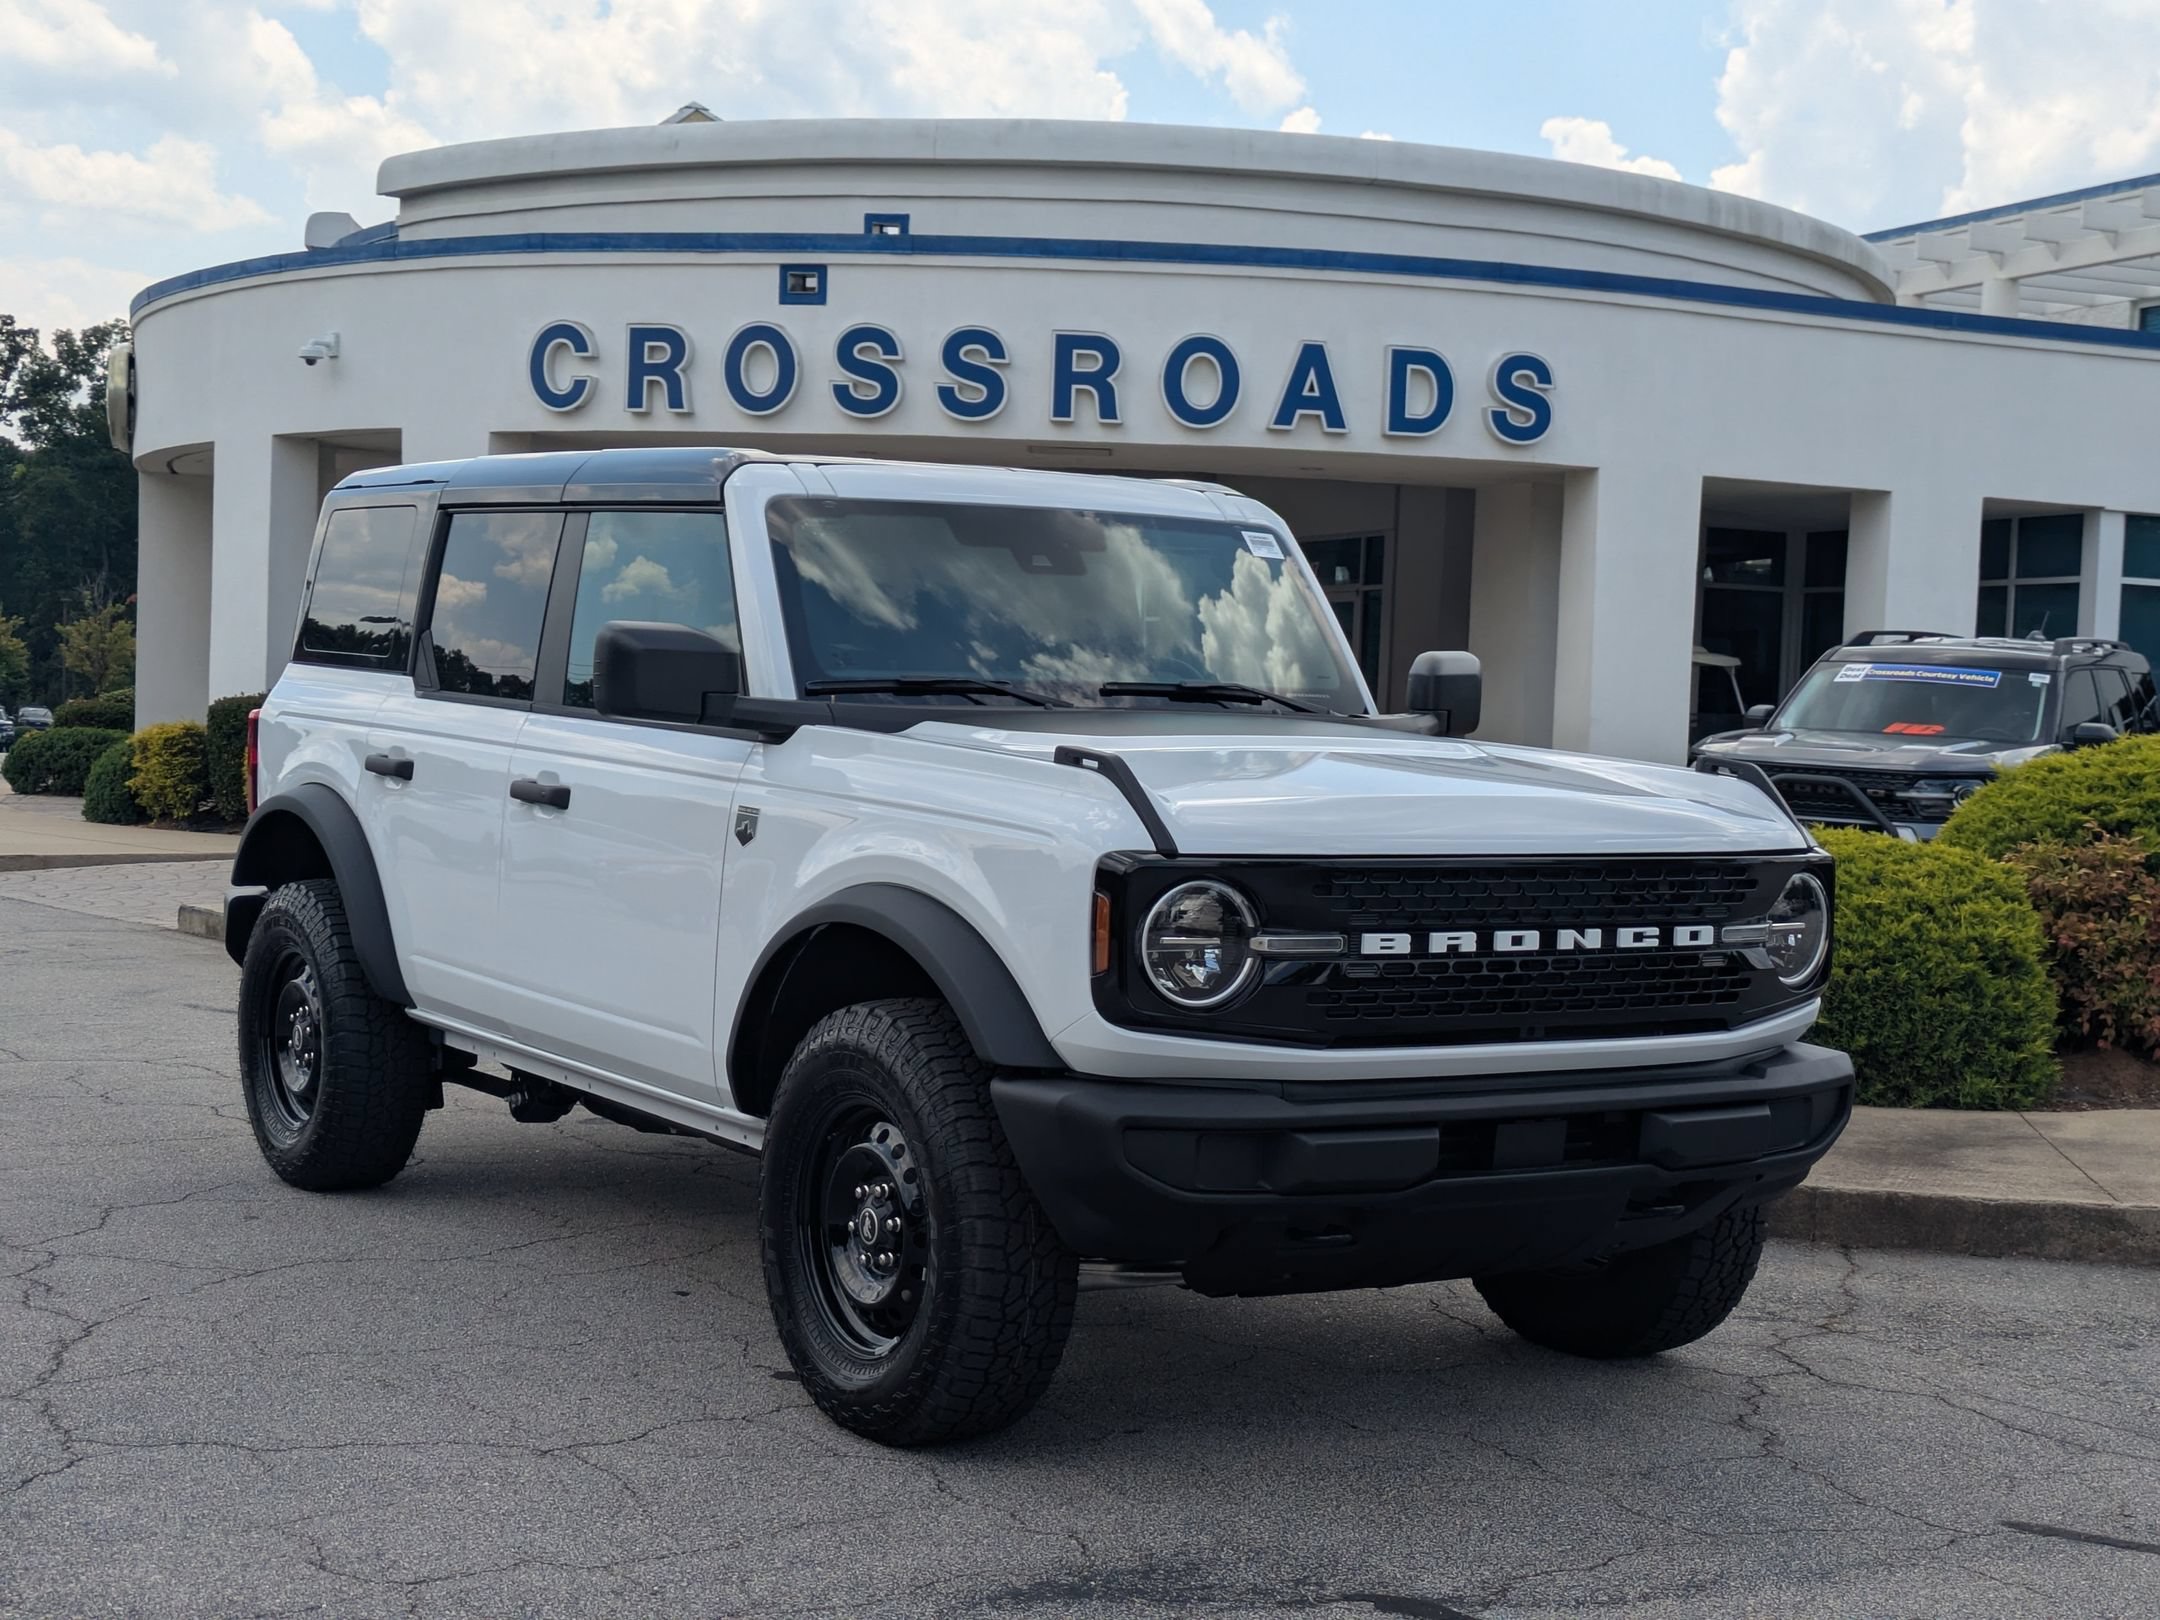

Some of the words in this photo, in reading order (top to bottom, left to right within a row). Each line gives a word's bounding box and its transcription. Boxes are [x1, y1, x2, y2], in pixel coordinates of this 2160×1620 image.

[529, 319, 1556, 446] CROSSROADS
[1866, 669, 1915, 677] Crossroads
[1916, 671, 1957, 680] Courtesy
[1959, 673, 1995, 682] Vehicle
[1360, 925, 1715, 955] BRONCO
